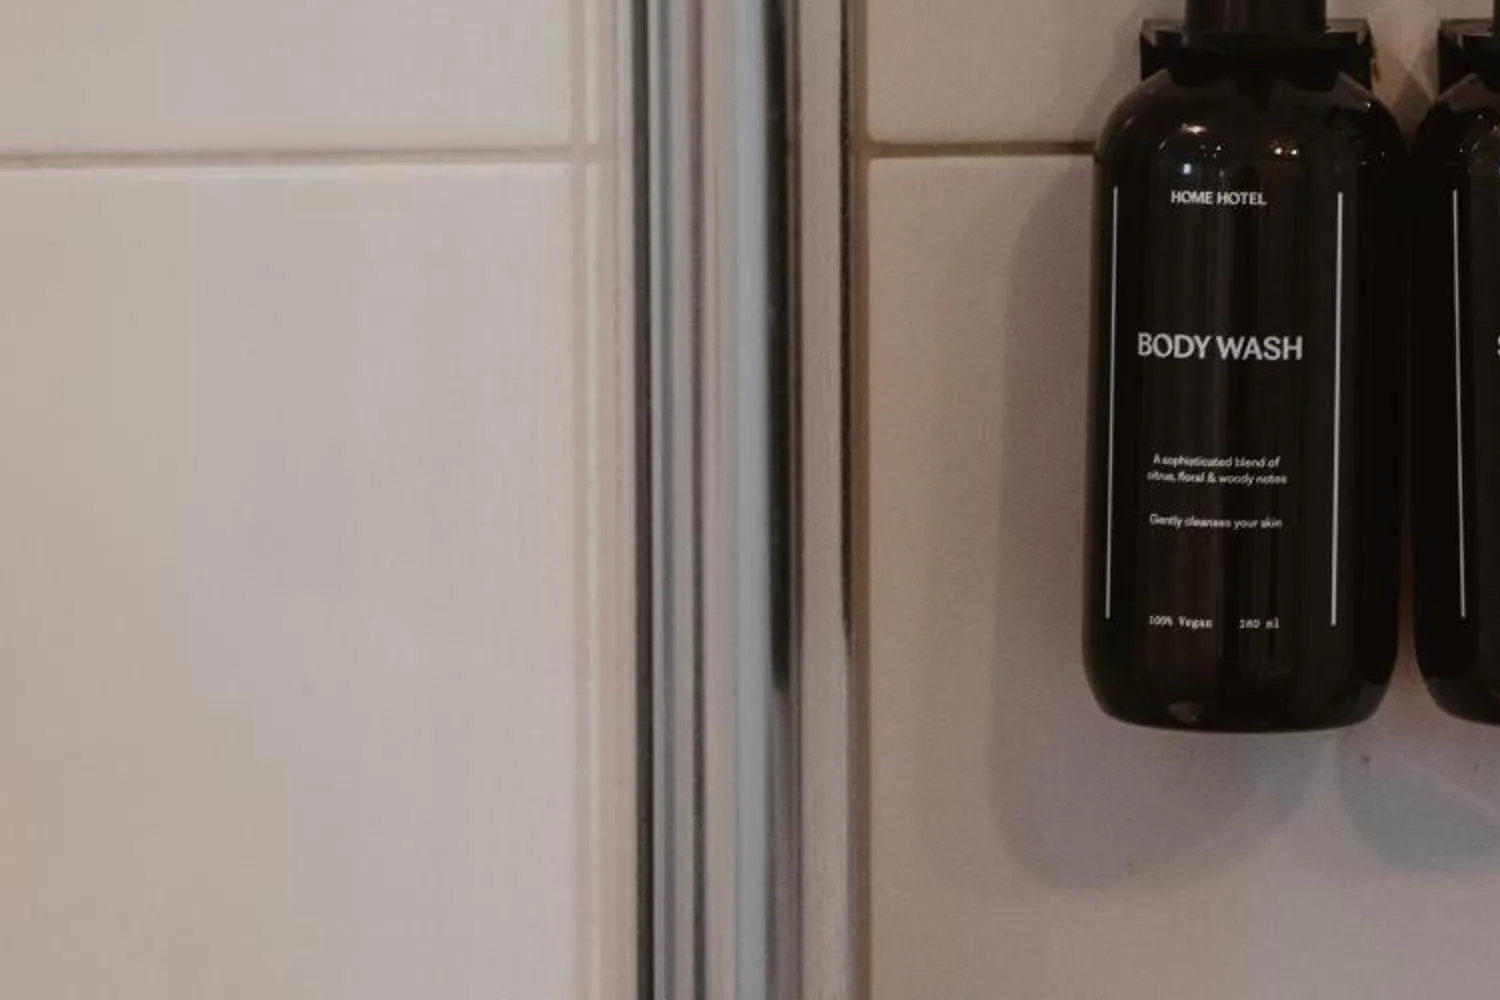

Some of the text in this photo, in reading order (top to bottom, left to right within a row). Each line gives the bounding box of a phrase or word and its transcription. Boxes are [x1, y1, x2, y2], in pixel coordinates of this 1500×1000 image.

[1170, 190, 1268, 206] HOME HOTEL
[1136, 331, 1303, 361] BODY WASH
[1153, 453, 1160, 464] A
[1234, 456, 1266, 468] blend
[1267, 456, 1281, 468] of
[1207, 471, 1216, 483] &
[1218, 473, 1254, 486] woody
[1149, 513, 1182, 530] Gently
[1233, 520, 1259, 530] your
[1260, 516, 1283, 528] skin
[1179, 616, 1213, 629] Vegan
